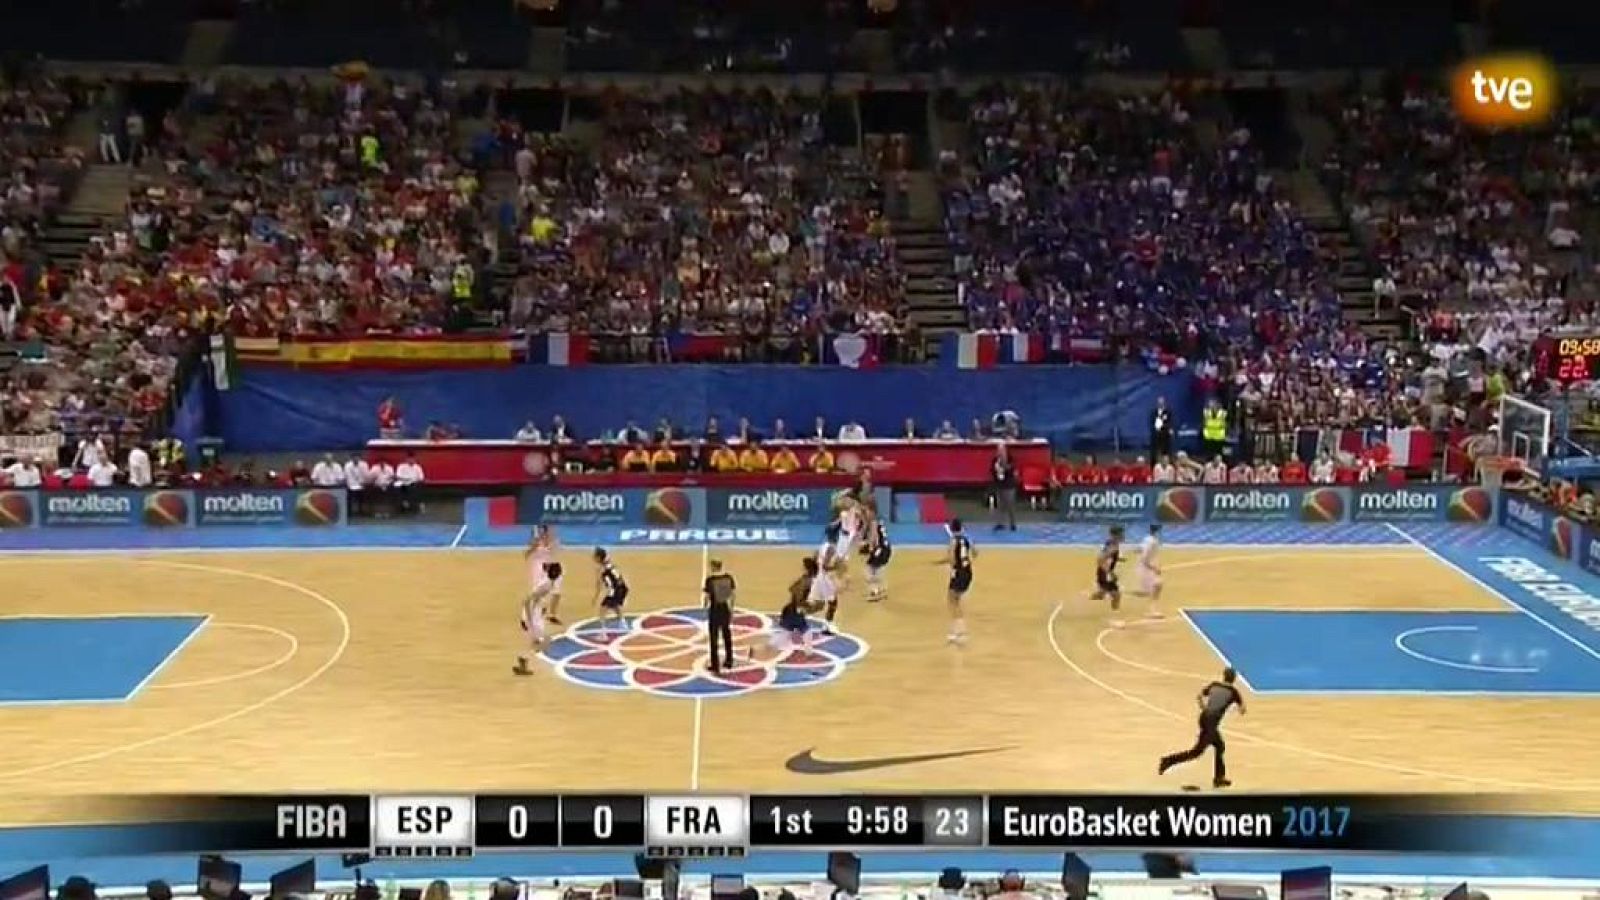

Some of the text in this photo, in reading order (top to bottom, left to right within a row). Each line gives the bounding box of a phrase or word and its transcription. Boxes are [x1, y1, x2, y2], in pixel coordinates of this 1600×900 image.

[48, 494, 131, 512] molten
[204, 493, 284, 512] molten
[543, 491, 624, 511] molten
[729, 491, 809, 510] molten
[1069, 491, 1145, 509] molten
[1213, 491, 1290, 509] molten
[1360, 491, 1437, 509] molten
[619, 528, 791, 541] PRAGUE
